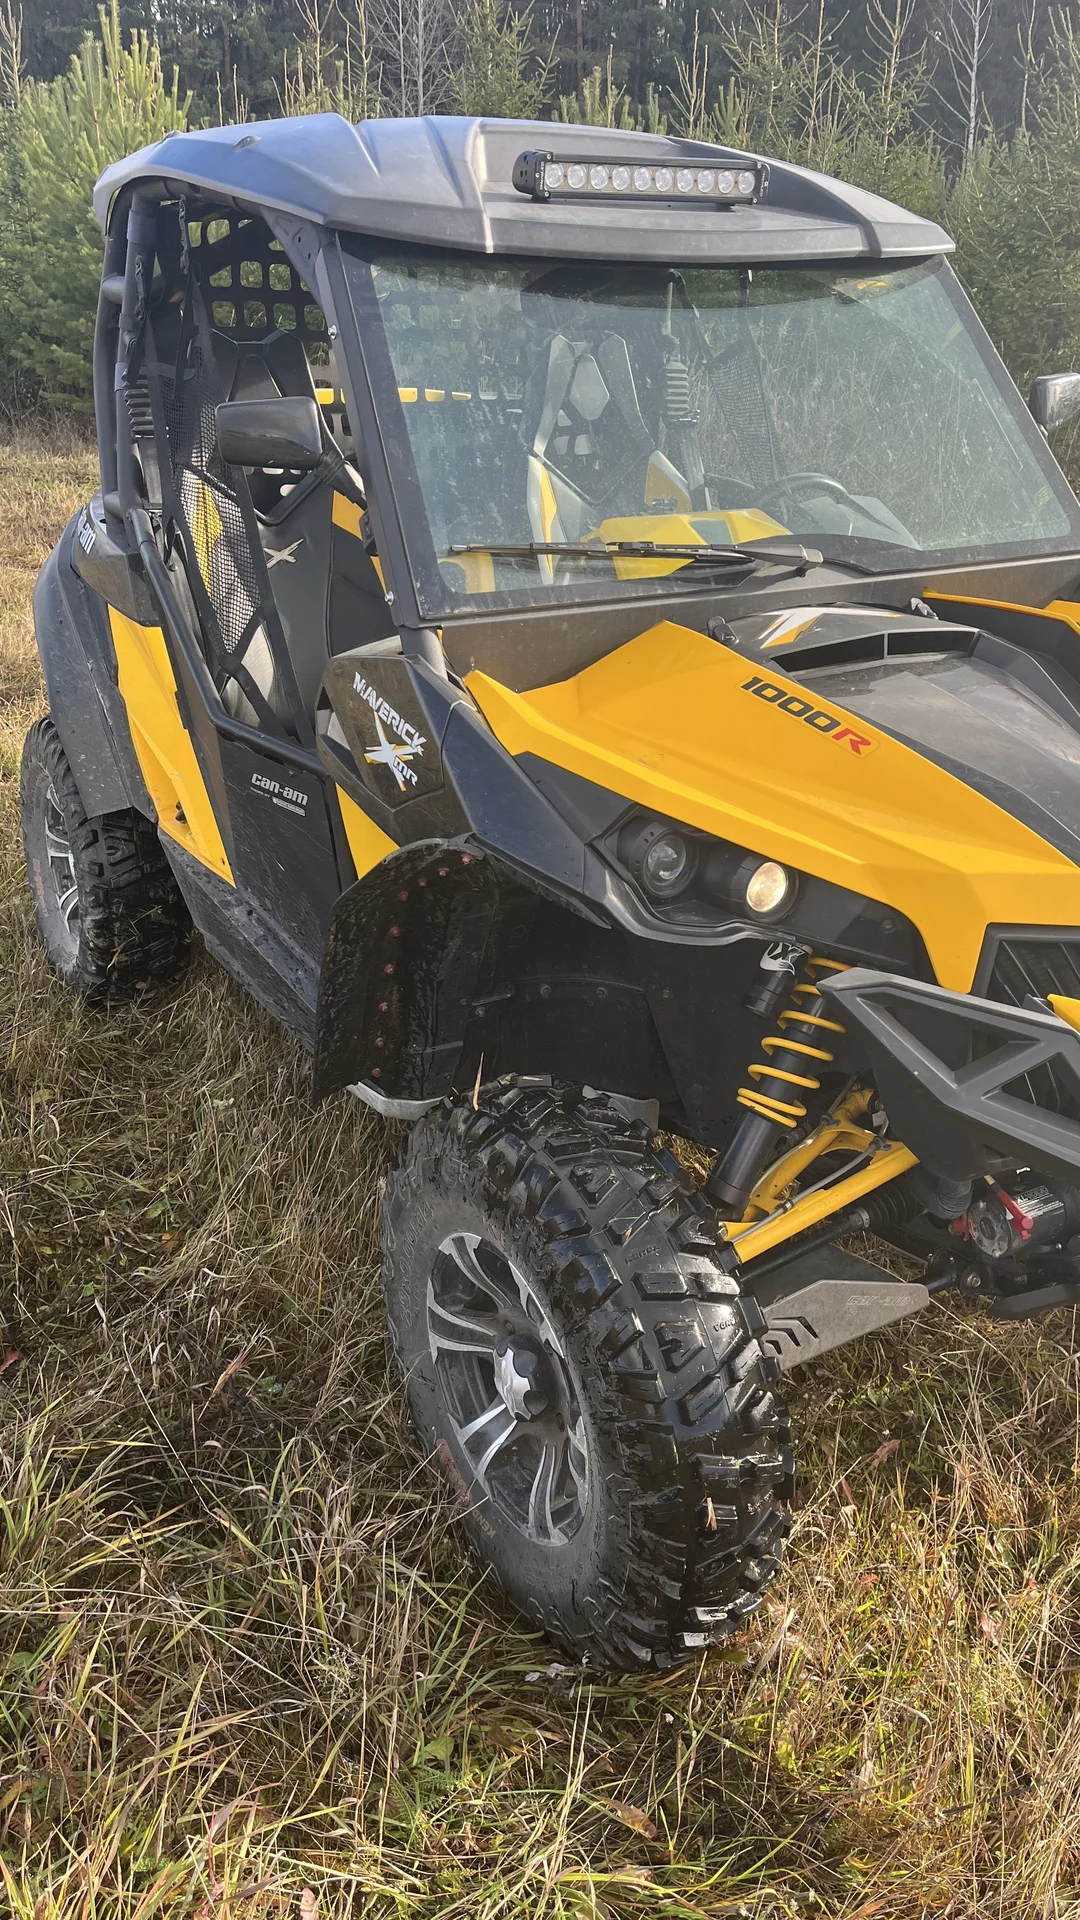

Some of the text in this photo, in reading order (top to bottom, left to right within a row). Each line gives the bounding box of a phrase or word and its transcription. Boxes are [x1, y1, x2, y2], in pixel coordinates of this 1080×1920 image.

[353, 671, 427, 756] MAVERICK
[741, 676, 871, 755] 1000R
[251, 773, 308, 806] can-am
